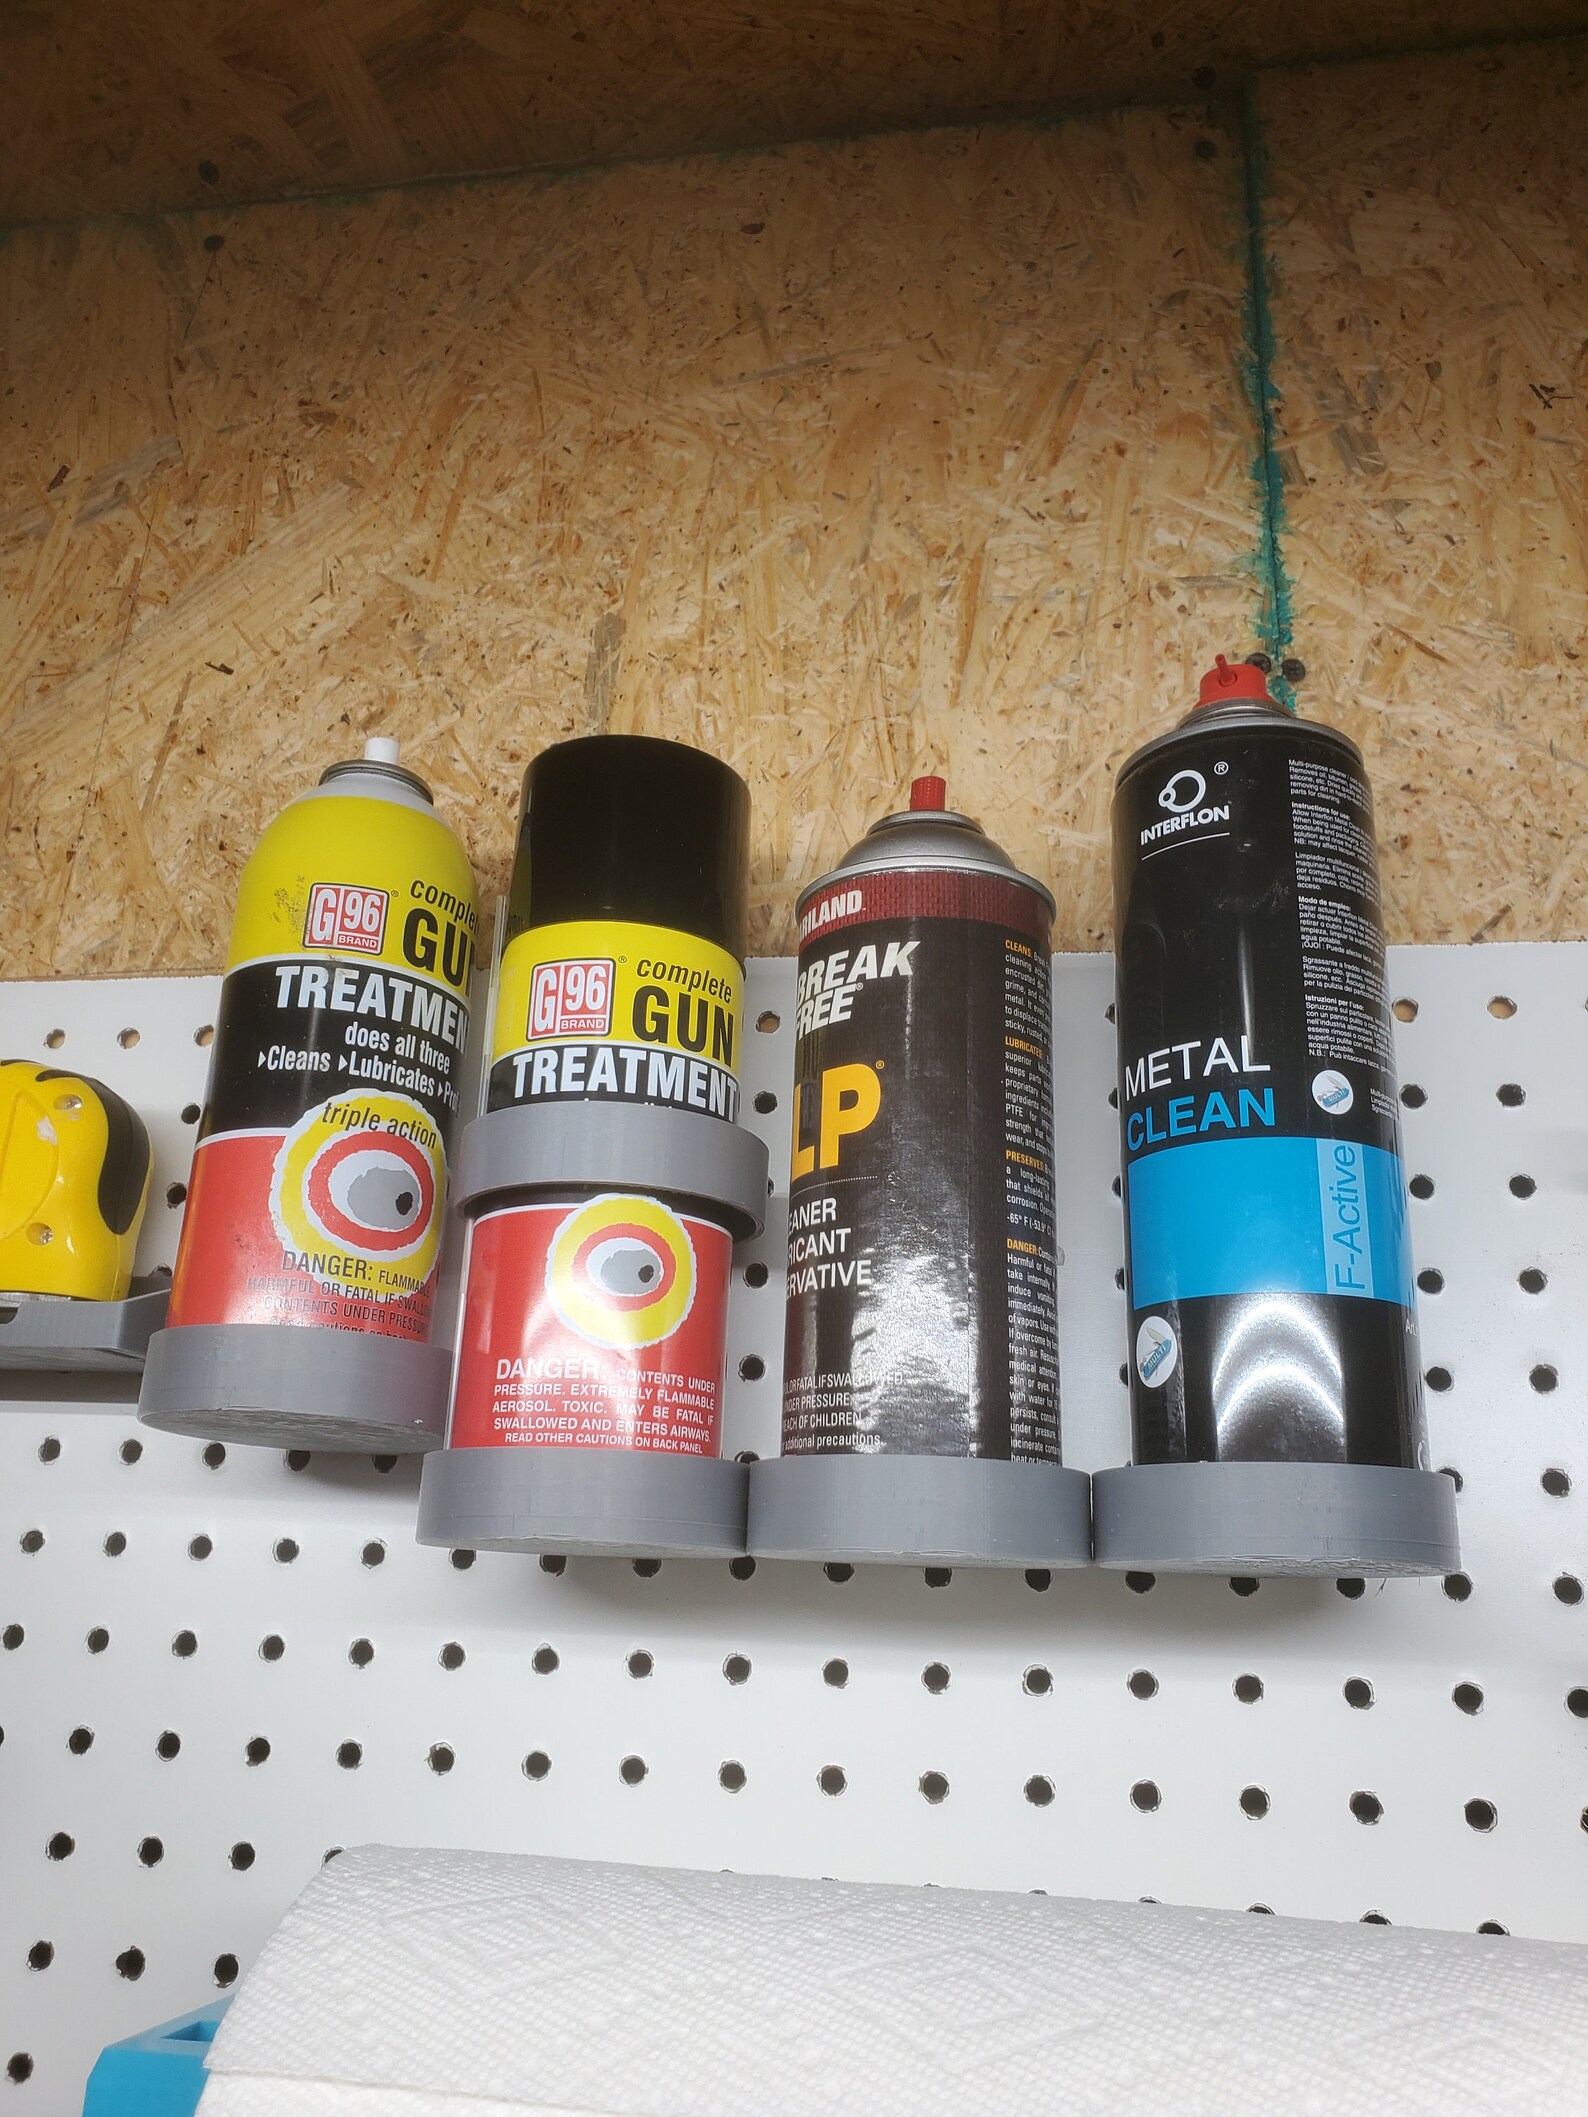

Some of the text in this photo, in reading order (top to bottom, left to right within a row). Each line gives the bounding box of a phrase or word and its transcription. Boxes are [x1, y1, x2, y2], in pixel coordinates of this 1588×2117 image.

[1288, 759, 1328, 773] Multi-purpose
[1289, 766, 1318, 777] Removes
[1290, 782, 1318, 792] removing
[1290, 789, 1306, 797] parts
[1291, 802, 1330, 813] Instructions
[1292, 809, 1310, 817] Allow
[1141, 805, 1229, 845] INTERFLON
[1292, 816, 1312, 825] When
[1293, 823, 1323, 834] foodstuffs
[1294, 831, 1318, 840] solution
[1308, 840, 1321, 848] may
[1295, 852, 1326, 863] Limpiador
[1296, 867, 1307, 876] por
[1297, 875, 1310, 884] deja
[1297, 882, 1322, 891] acceso.
[410, 881, 479, 934] complet
[1298, 896, 1318, 905] Modo
[311, 888, 381, 942] G96
[800, 890, 863, 941] RILAND
[1298, 904, 1316, 914] Dejar
[1300, 918, 1319, 927] retirar
[338, 934, 378, 948] BRAND
[1005, 953, 1032, 973] cleaning
[1302, 956, 1338, 967] Sgrassante
[637, 959, 732, 1004] complete
[797, 941, 921, 1008] BREAK
[1005, 967, 1036, 986] encrusted
[1005, 980, 1026, 996] grime,
[1304, 979, 1316, 987] per
[533, 964, 607, 1032] G96
[1305, 994, 1348, 1008] Istruzioni per
[796, 983, 858, 1041] FREE
[1005, 1004, 1013, 1016] to
[1306, 1002, 1338, 1013] Spruzzare
[1306, 1010, 1319, 1018] con
[1330, 1013, 1348, 1023] panno
[560, 1019, 604, 1032] BRAND
[632, 985, 734, 1068] GUN
[1005, 1018, 1026, 1034] sticky,
[1307, 1026, 1352, 1038] essere rimossi
[1308, 1034, 1336, 1045] superfici
[1308, 1042, 1330, 1052] acqua
[345, 1021, 451, 1079] does all three
[1005, 1051, 1032, 1067] superior
[267, 1045, 435, 1097] Cleans Lubricates
[1005, 1062, 1026, 1078] keeps
[1124, 1034, 1271, 1102] METAL
[512, 1048, 738, 1123] TREATMENT
[1005, 1090, 1040, 1111] ingredients
[1005, 1103, 1024, 1118] PTFE
[321, 1102, 437, 1150] triple action
[1005, 1118, 1032, 1135] strength
[1126, 1087, 1276, 1152] CLEAN
[1006, 1178, 1021, 1192] that
[1329, 1144, 1366, 1289] F-Active
[282, 1250, 373, 1281] DANGER:
[1007, 1252, 1035, 1269] Harmful
[1007, 1268, 1024, 1281] take
[247, 1277, 395, 1306] HARMFUL OR FATAL IF
[1008, 1282, 1032, 1298] induce
[264, 1296, 386, 1324] CONTENTS UNDER
[1008, 1312, 1017, 1324] of
[1008, 1328, 1046, 1346] If overcome
[1008, 1342, 1028, 1356] fresh
[1008, 1358, 1036, 1374] medical
[617, 1368, 684, 1388] CONTENTS
[688, 1376, 716, 1395] UNDER
[796, 1376, 818, 1392] FATAL
[818, 1374, 827, 1389] IF
[1009, 1374, 1035, 1388] skin or
[570, 1383, 654, 1401] EXTREMELY
[657, 1388, 715, 1411] FLAMMABLE
[1009, 1390, 1046, 1407] with water
[492, 1400, 715, 1426] AEROSOL. TOXIC. MAY BE FATAL IF
[493, 1417, 711, 1443] SWALLOWED AND ENTERS AIRWAYS.
[798, 1415, 808, 1430] OF
[1010, 1422, 1032, 1434] under
[504, 1432, 703, 1454] READ OTHER CAUTIONS ON BACK PANEL
[1010, 1436, 1044, 1452] incinerate
